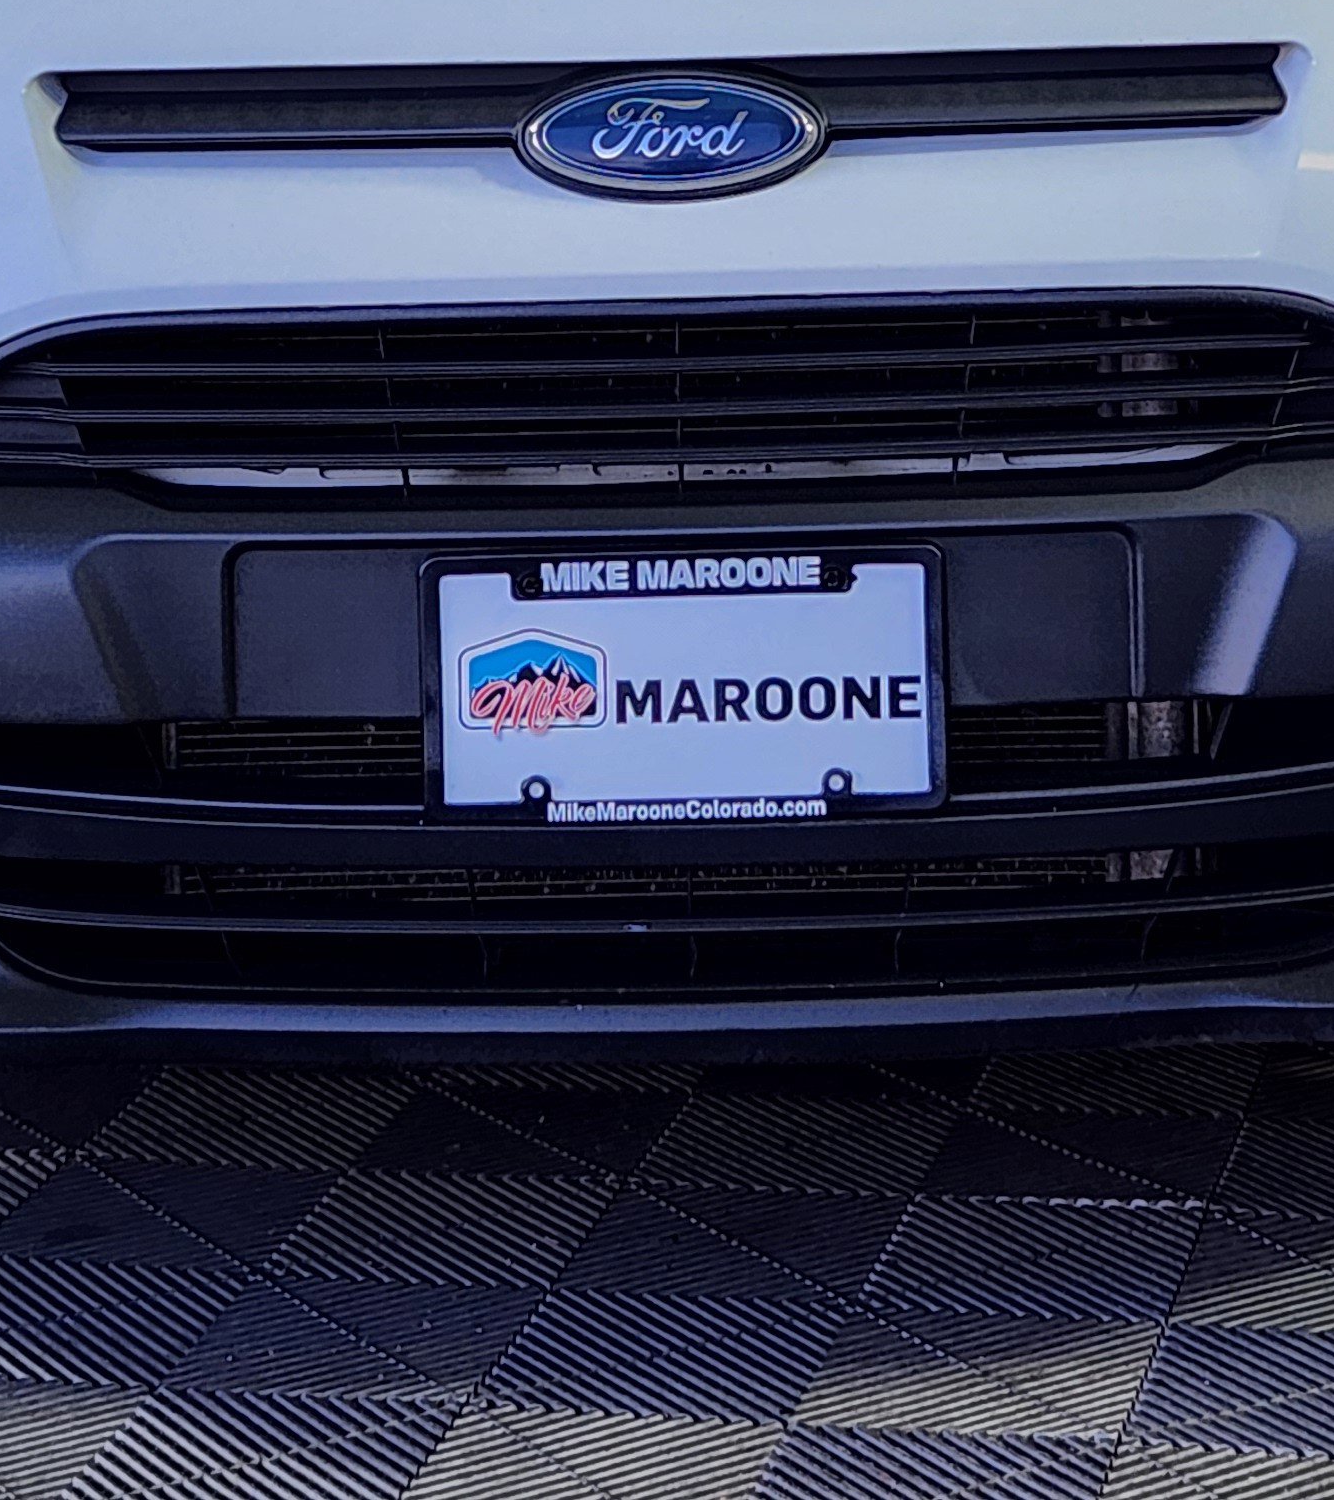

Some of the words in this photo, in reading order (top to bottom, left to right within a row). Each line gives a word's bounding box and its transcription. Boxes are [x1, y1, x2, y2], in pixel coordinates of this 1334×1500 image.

[592, 97, 749, 159] Ford
[541, 561, 630, 592] MIKE
[637, 556, 821, 590] MAROONE
[471, 675, 596, 735] Mike
[615, 675, 922, 724] MAROONE
[547, 800, 827, 823] MikeMarooneColorado.com
